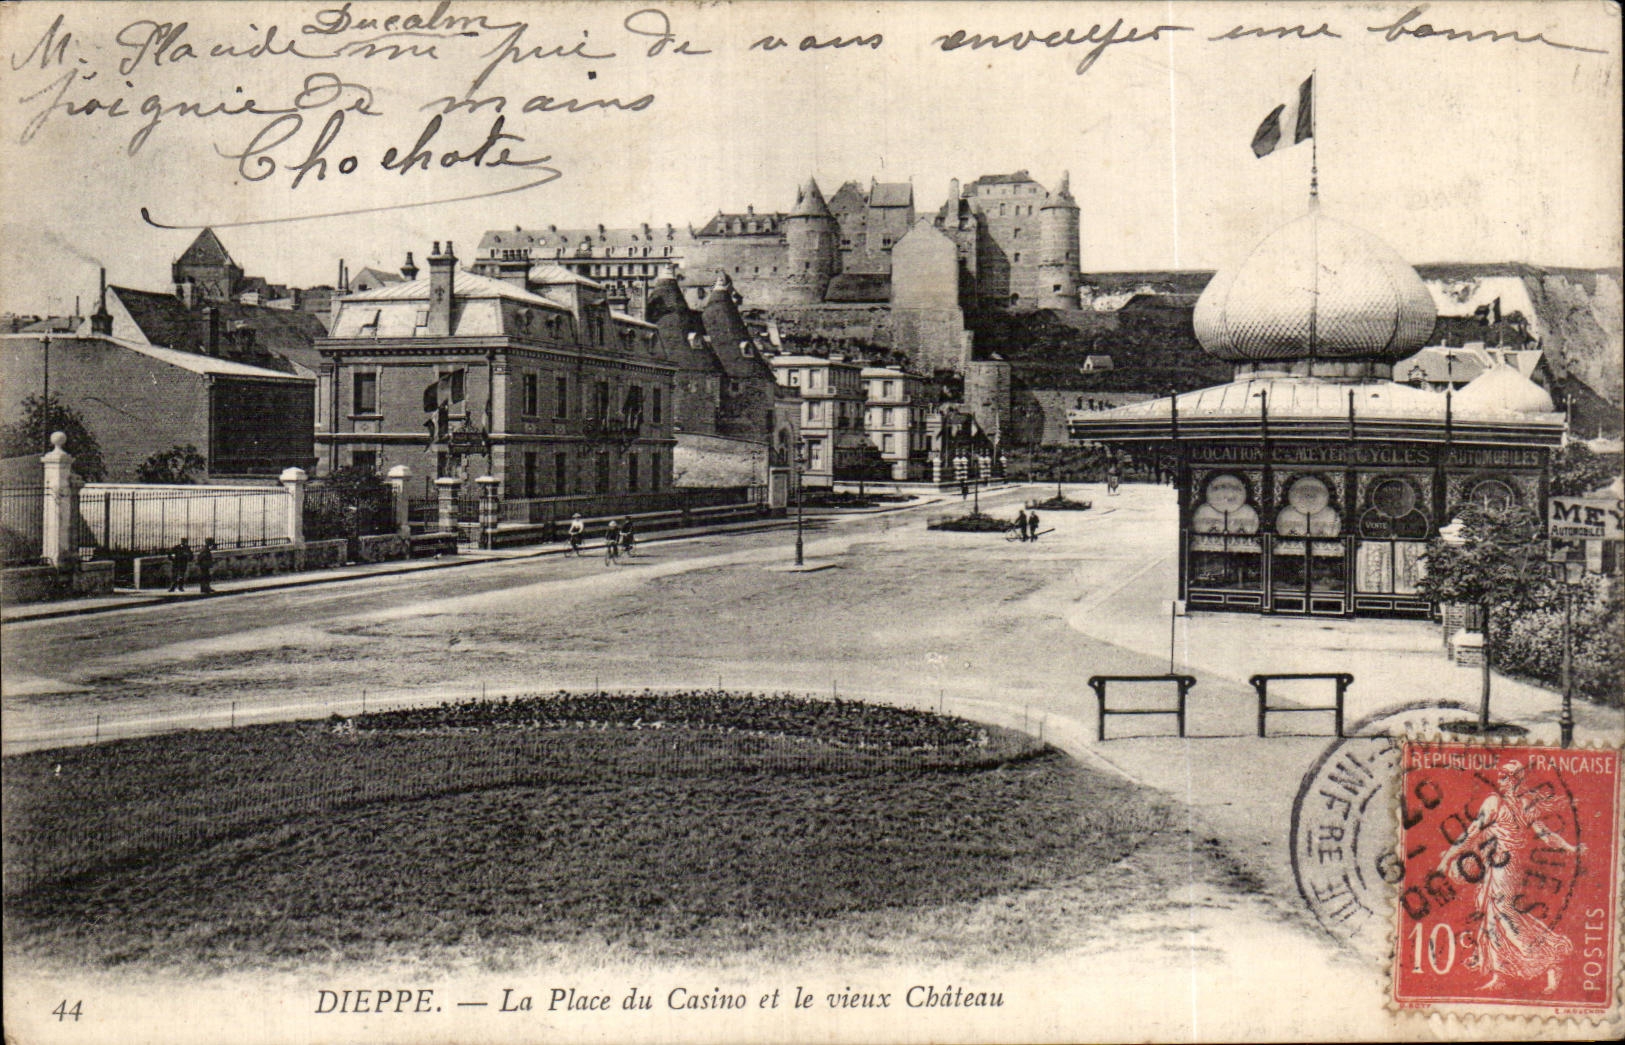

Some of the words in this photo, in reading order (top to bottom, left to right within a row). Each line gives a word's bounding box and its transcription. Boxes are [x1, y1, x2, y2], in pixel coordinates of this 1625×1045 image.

[1191, 446, 1264, 461] LOCATION
[1356, 448, 1430, 465] CYCLES
[1449, 449, 1540, 466] AUTOMOBILES
[1527, 755, 1614, 775] FRANÇAISE
[1583, 906, 1606, 991] POSTES
